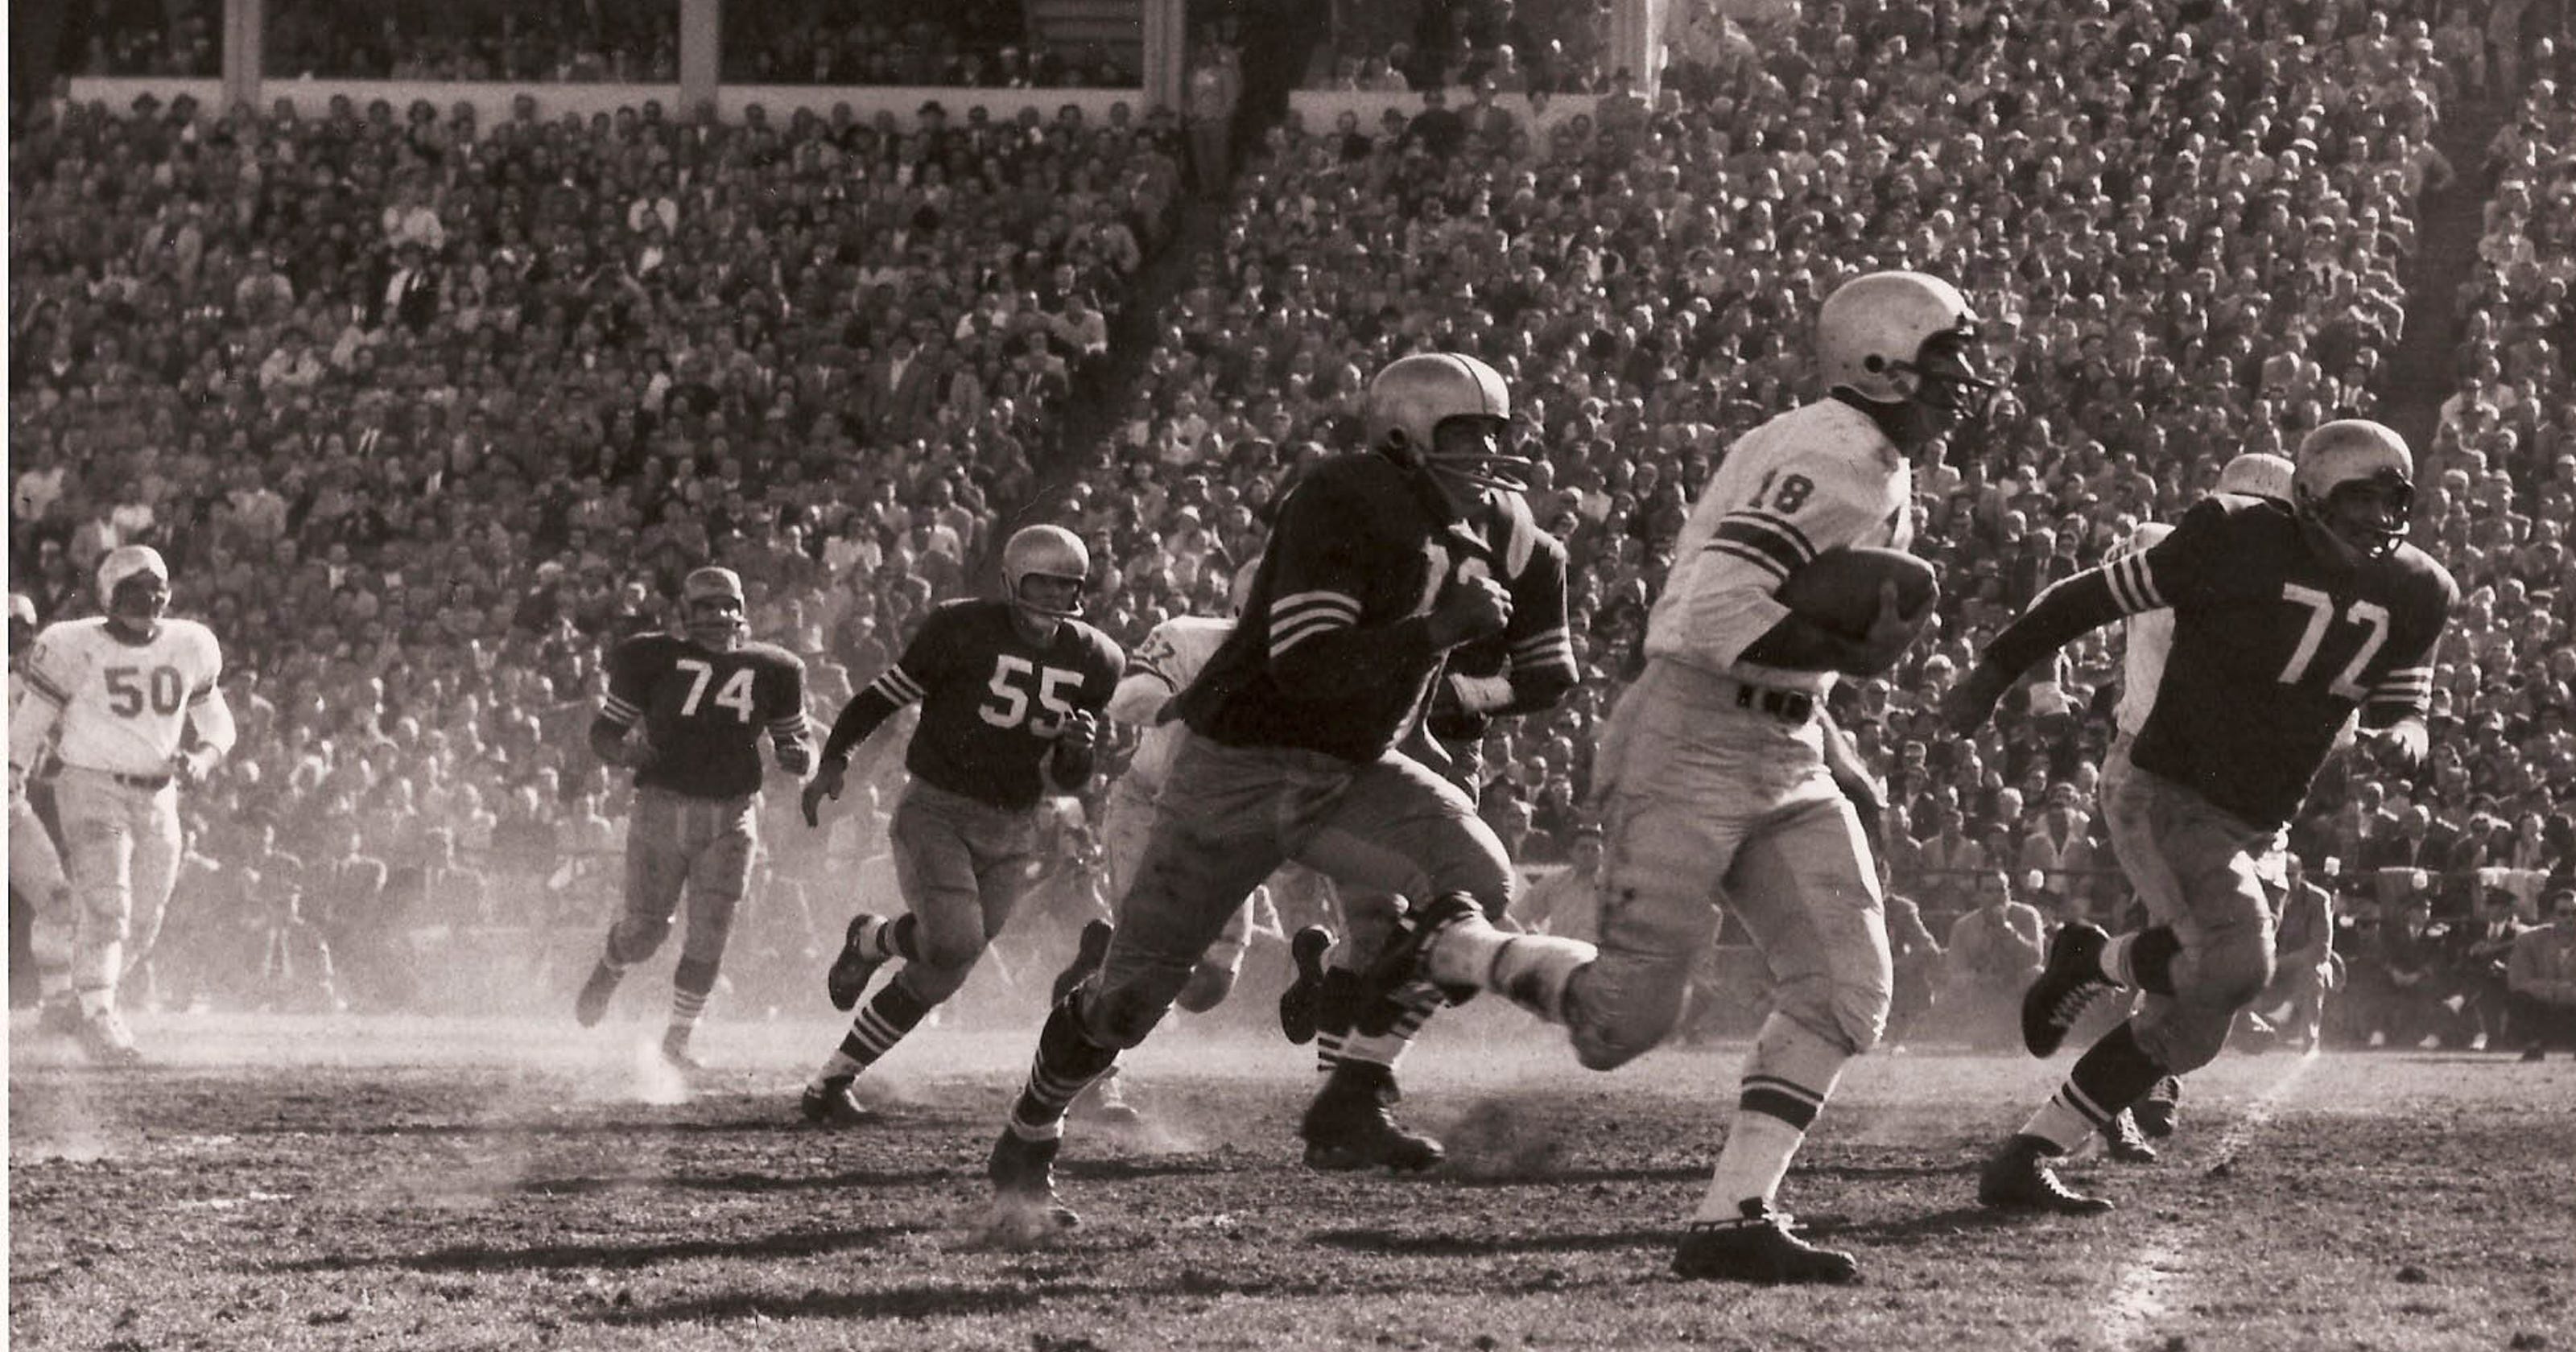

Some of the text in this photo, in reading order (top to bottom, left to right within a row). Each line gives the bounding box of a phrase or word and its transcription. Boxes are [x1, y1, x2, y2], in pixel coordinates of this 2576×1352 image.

[1748, 468, 1815, 514] 18
[2277, 582, 2390, 700] 72
[103, 666, 183, 719] 50
[676, 658, 756, 723] 74
[978, 653, 1085, 738] 55
